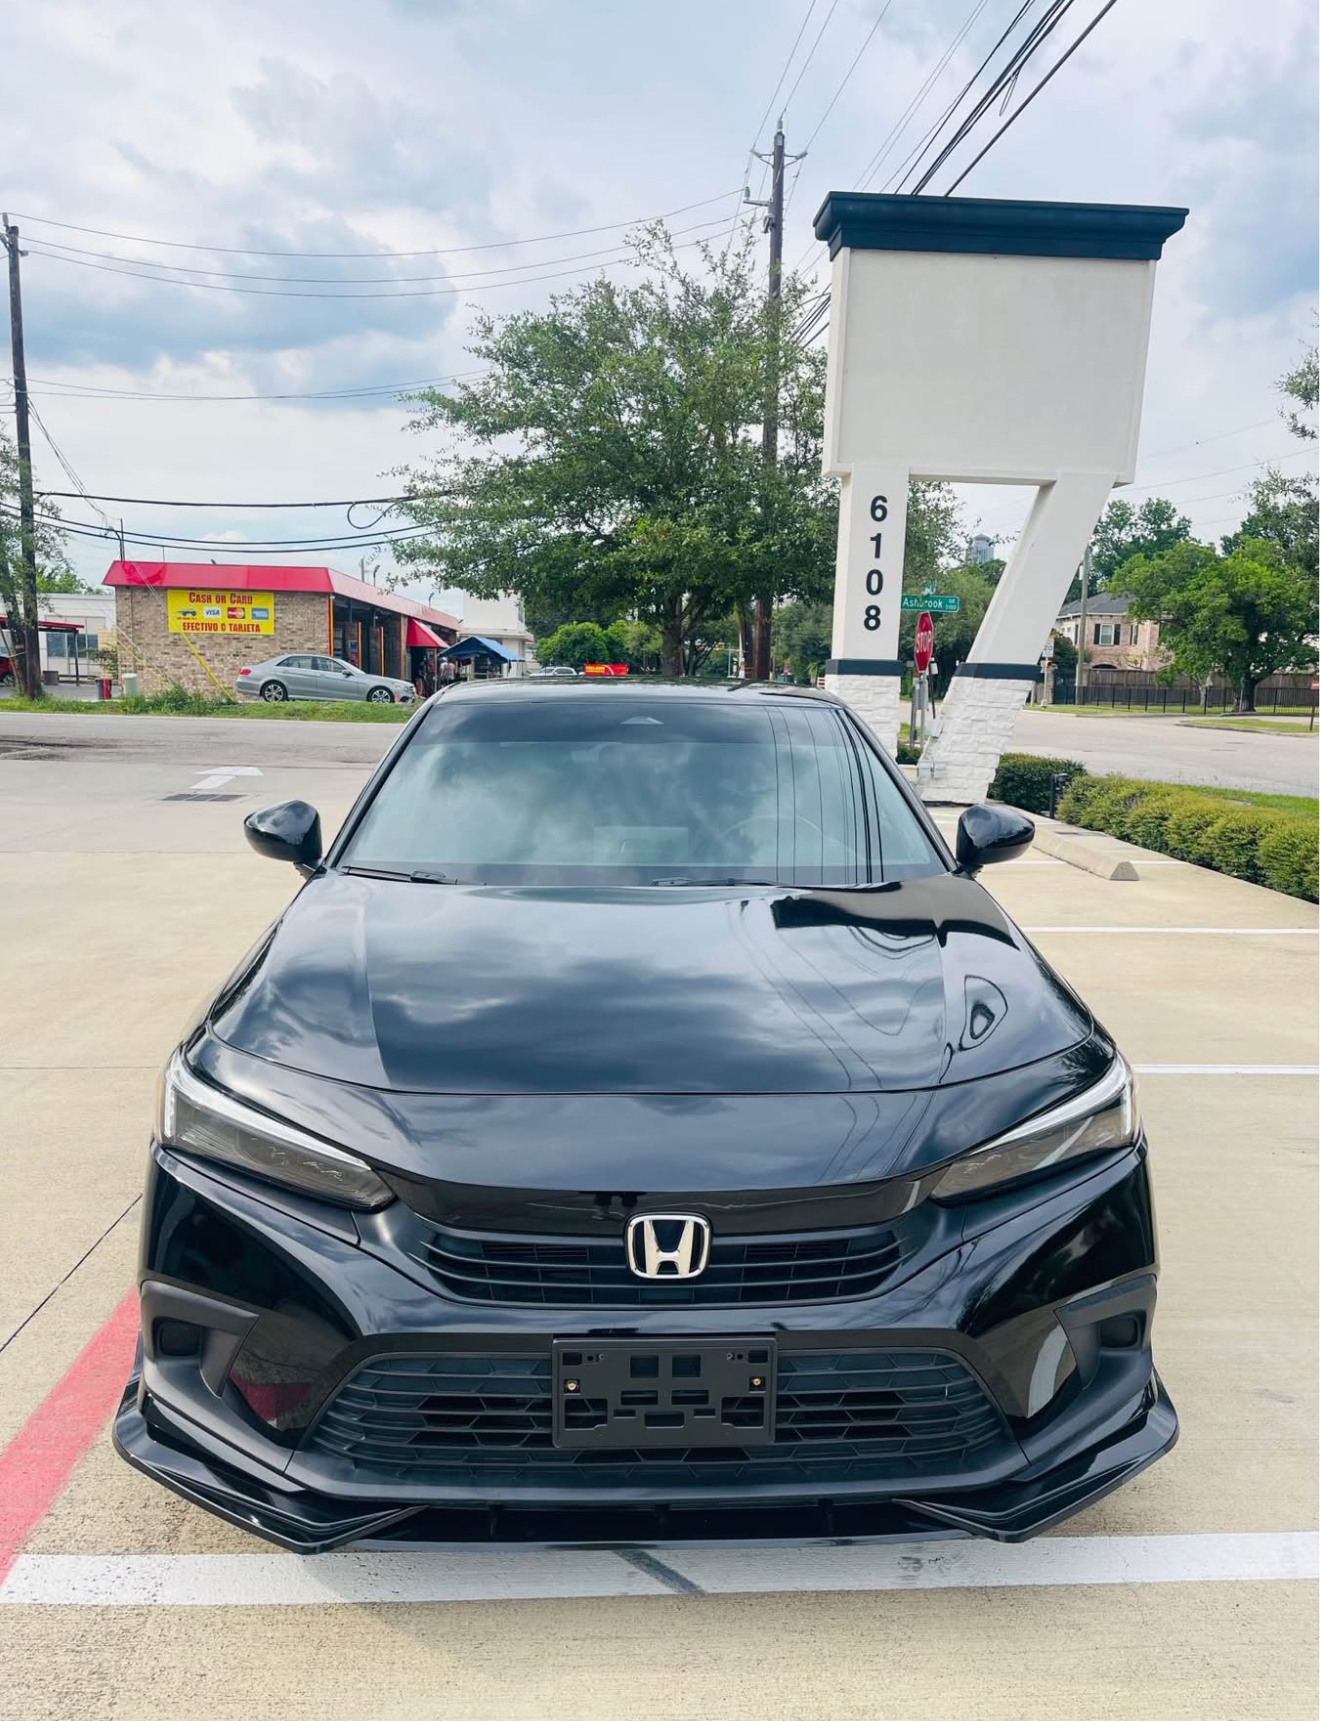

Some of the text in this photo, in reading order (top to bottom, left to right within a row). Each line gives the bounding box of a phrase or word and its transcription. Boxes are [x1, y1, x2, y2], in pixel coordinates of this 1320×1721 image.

[863, 495, 888, 632] 6108
[182, 622, 261, 633] EFECTIVO O TARJETA
[916, 631, 932, 653] STOP
